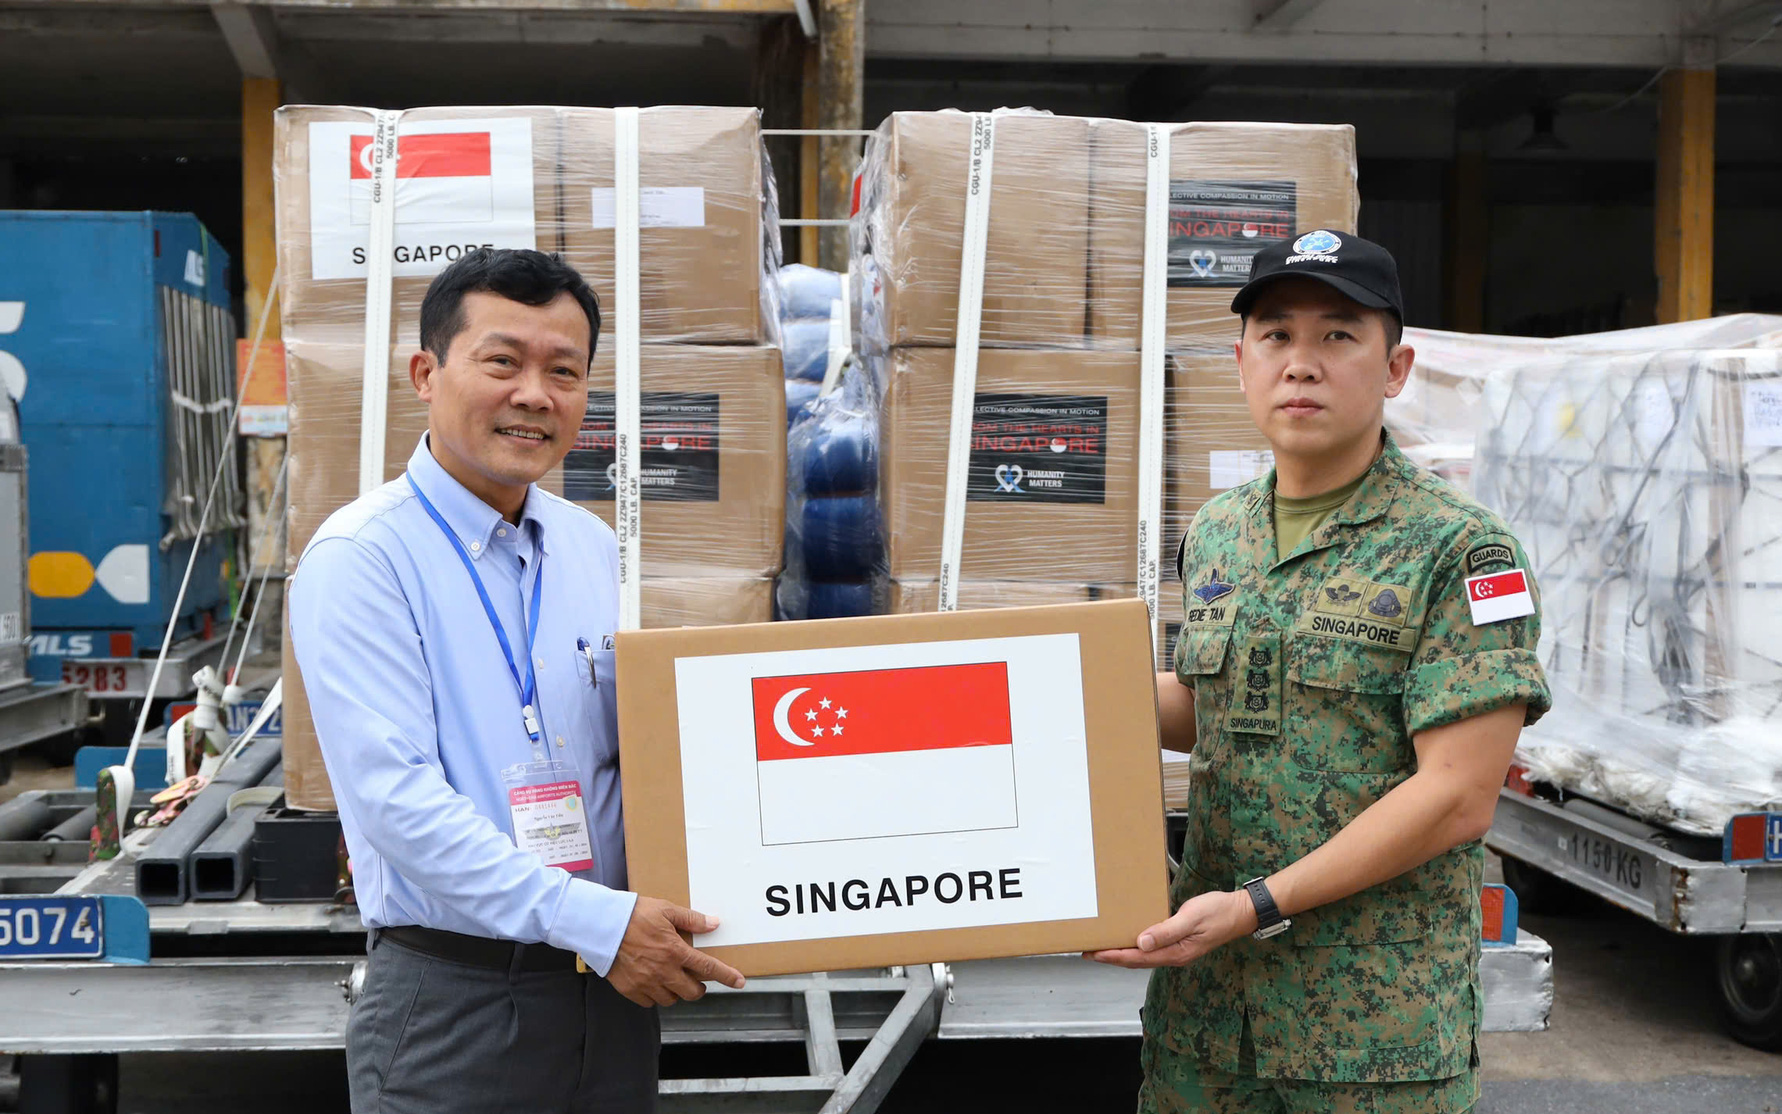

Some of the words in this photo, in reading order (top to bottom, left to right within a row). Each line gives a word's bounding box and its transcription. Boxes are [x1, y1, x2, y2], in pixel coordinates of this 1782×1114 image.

[375, 146, 383, 165] CL2
[386, 138, 394, 159] 5000
[974, 139, 982, 157] CL2
[374, 167, 382, 203] CGU-1/B
[971, 158, 981, 196] CGU-1/B
[1195, 209, 1219, 218] THE
[1224, 210, 1272, 219] HEARTS
[1169, 221, 1289, 238] INGAPORE
[352, 244, 494, 264] SGAPO
[1003, 423, 1026, 432] THE
[1032, 424, 1082, 434] HEARTS
[1087, 425, 1099, 434] IN
[971, 435, 1099, 453] INGAPORE
[641, 477, 675, 485] MATTERS
[1027, 470, 1065, 478] HUMANITY
[1028, 479, 1063, 487] MATTERS
[619, 524, 627, 543] CL2
[630, 515, 638, 537] 5000
[1472, 549, 1509, 563] GUARDS
[1209, 607, 1226, 621] TAN
[1312, 616, 1400, 645] SINGAPORE
[1230, 718, 1277, 731] SINGAPURA
[1570, 833, 1612, 874] 1150
[1616, 851, 1642, 889] KG
[765, 868, 1023, 917] SINGAPORE
